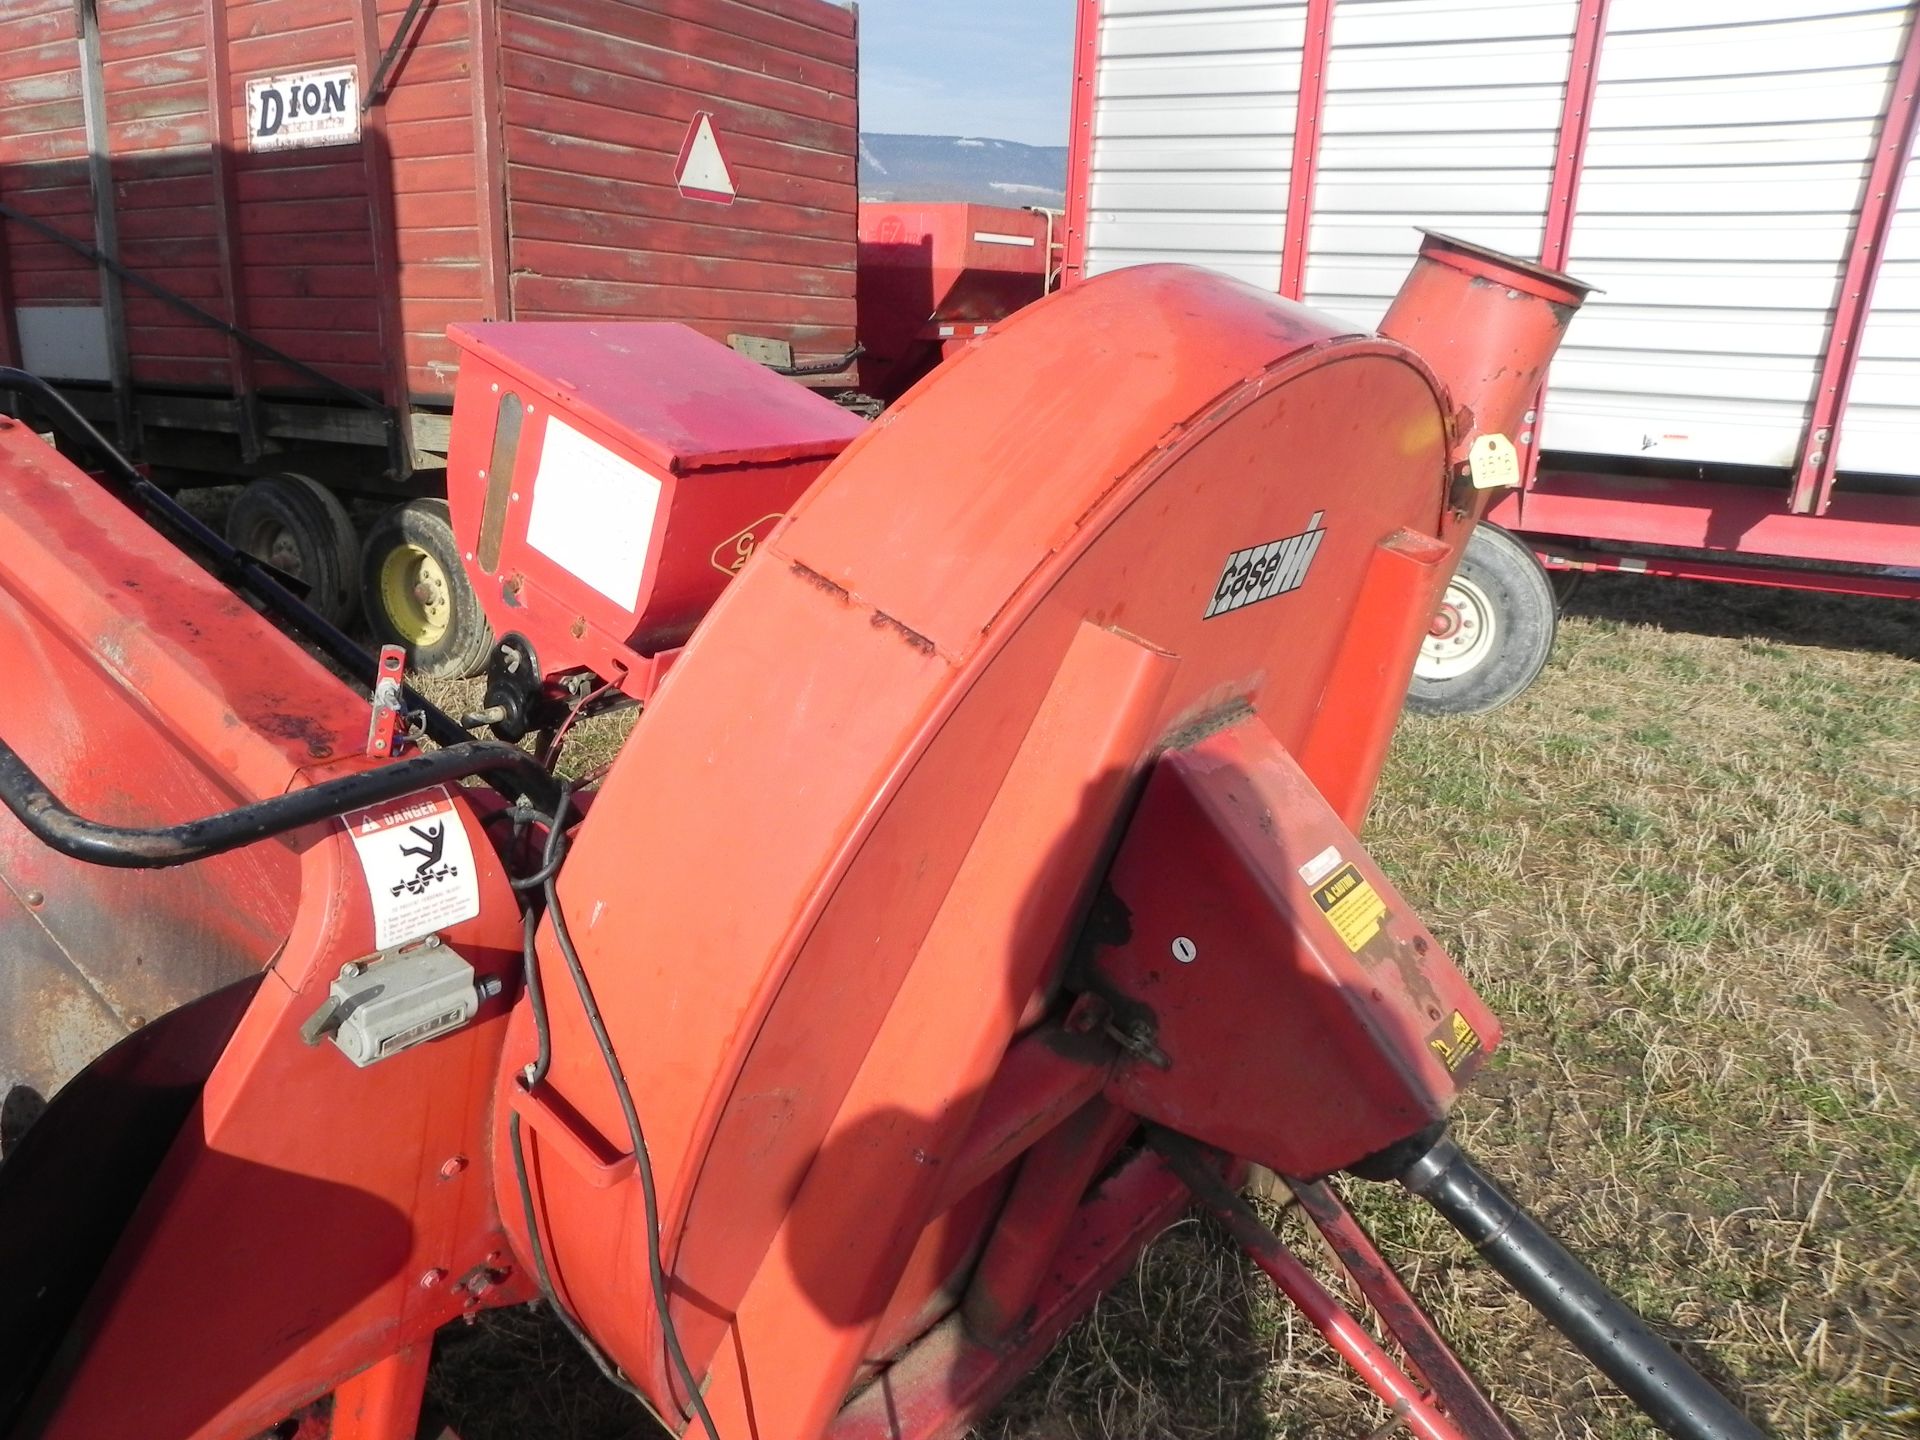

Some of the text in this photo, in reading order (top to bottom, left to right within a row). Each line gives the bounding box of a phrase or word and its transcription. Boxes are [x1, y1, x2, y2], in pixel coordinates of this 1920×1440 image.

[256, 78, 350, 137] DION
[383, 801, 438, 826] DANGER
[1331, 873, 1357, 898] CAUTION
